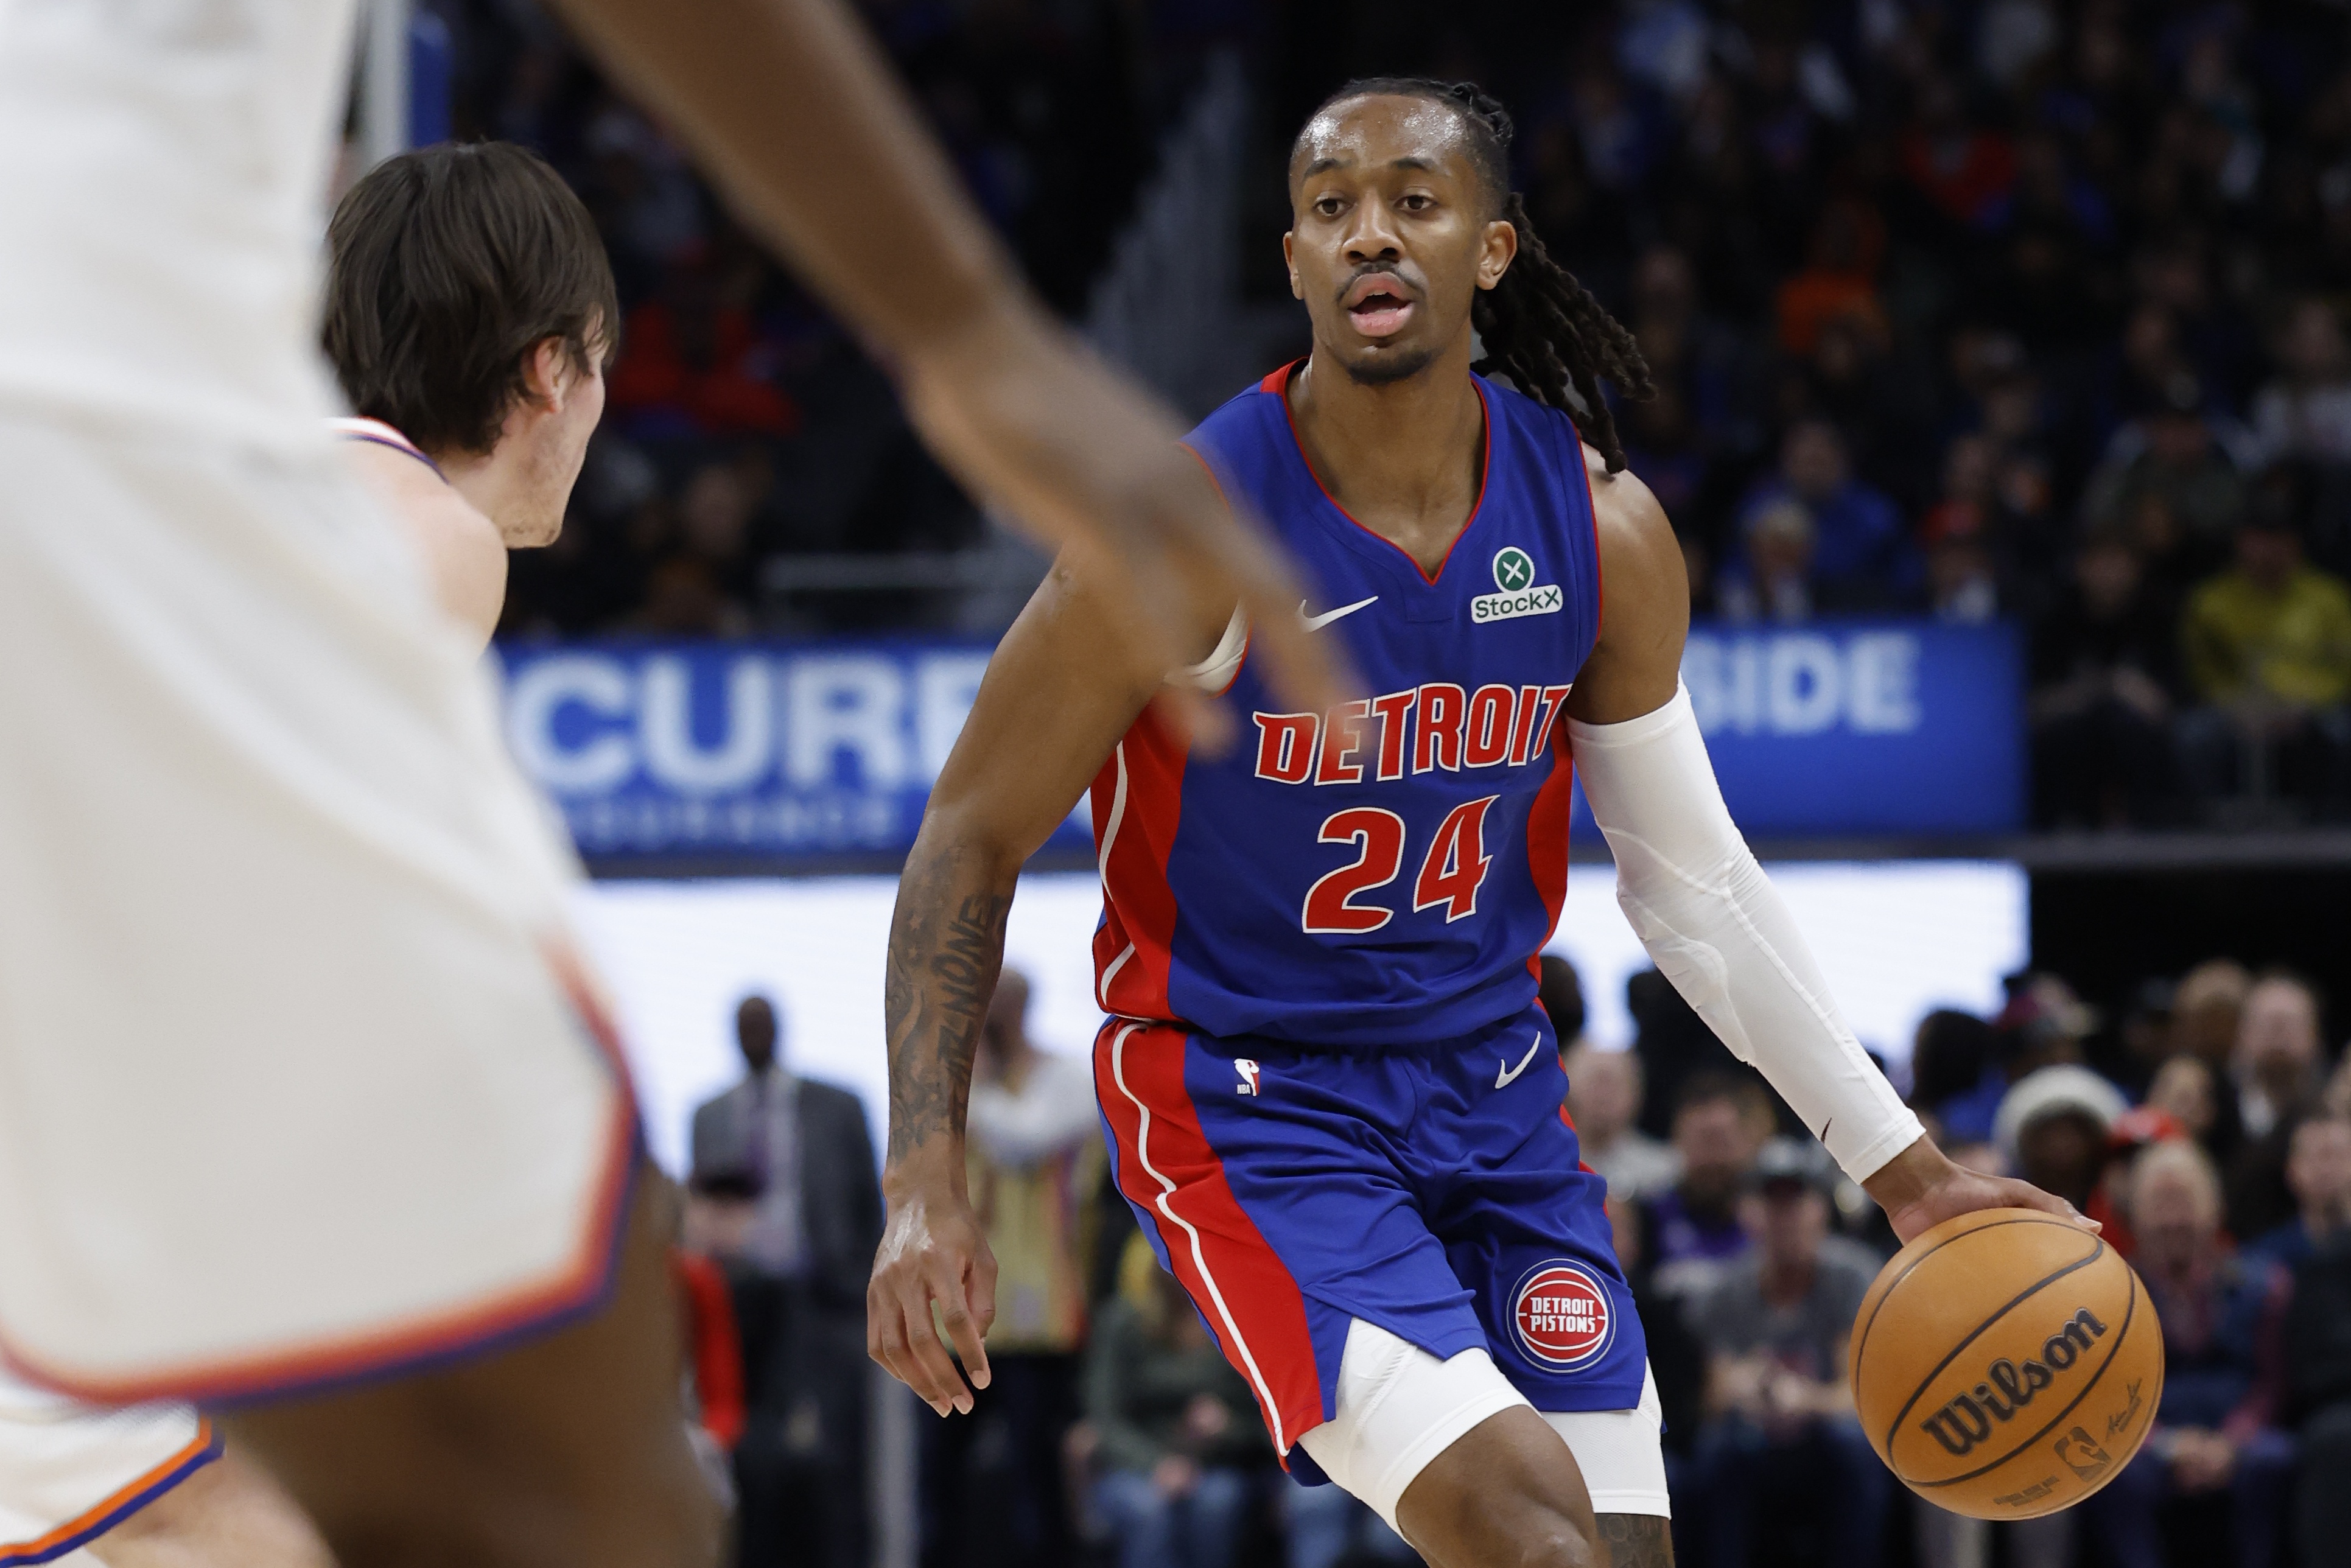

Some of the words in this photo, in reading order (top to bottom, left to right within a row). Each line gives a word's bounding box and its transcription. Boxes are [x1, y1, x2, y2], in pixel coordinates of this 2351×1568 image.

[1475, 588, 1560, 618] StockX
[1253, 683, 1573, 786] DETROIT
[1302, 794, 1500, 934] 24
[1236, 1083, 1251, 1094] NBA
[1530, 1297, 1595, 1315] DETROIT
[1529, 1315, 1596, 1334] PISTONS
[1919, 1307, 2107, 1457] Wilson
